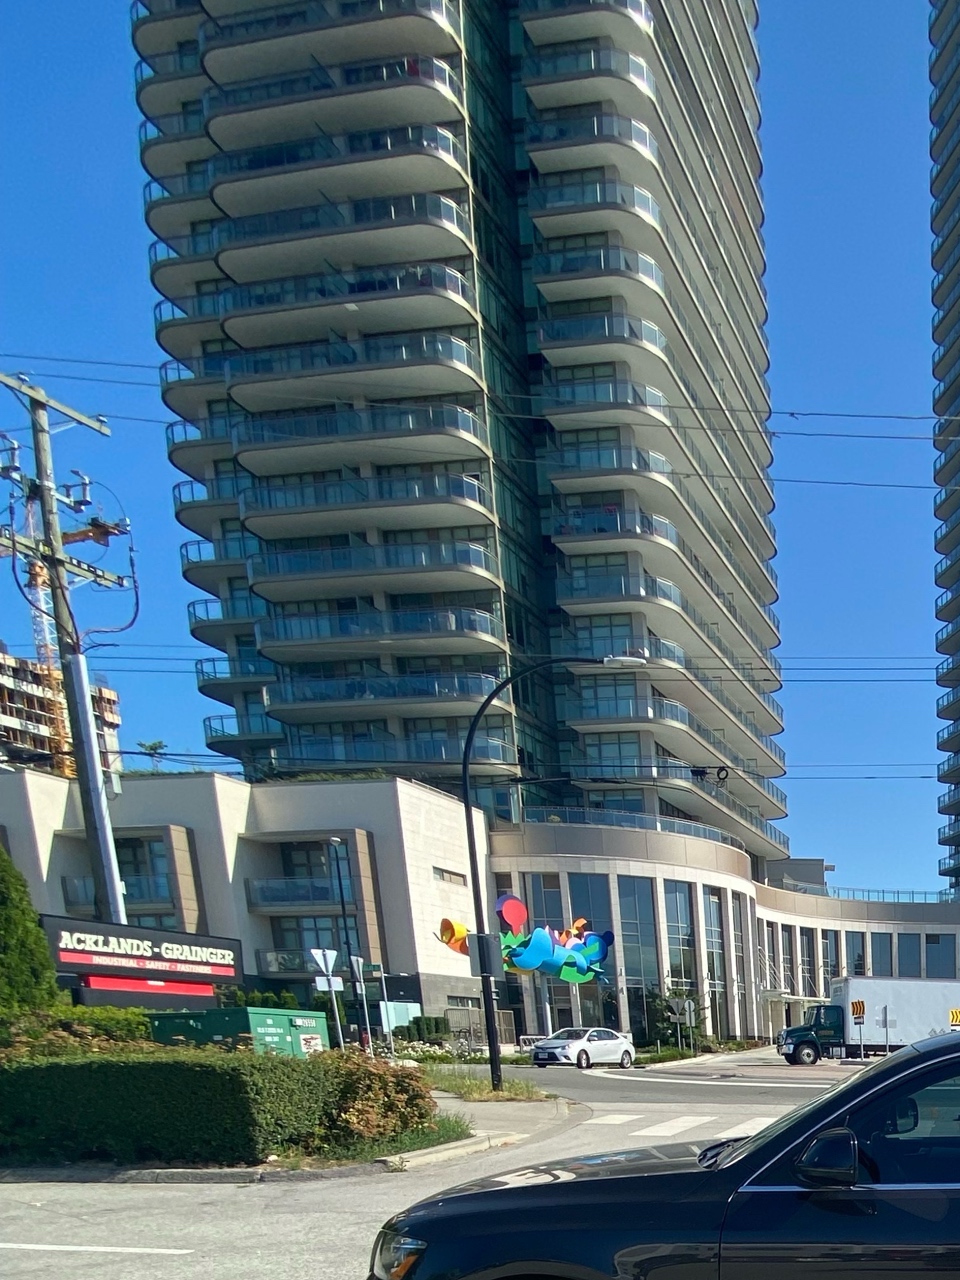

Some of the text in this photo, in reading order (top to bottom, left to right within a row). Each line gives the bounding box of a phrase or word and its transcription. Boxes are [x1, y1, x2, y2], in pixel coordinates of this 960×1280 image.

[92, 955, 212, 974] INDUSTRIAL SAFETY FASTENERS
